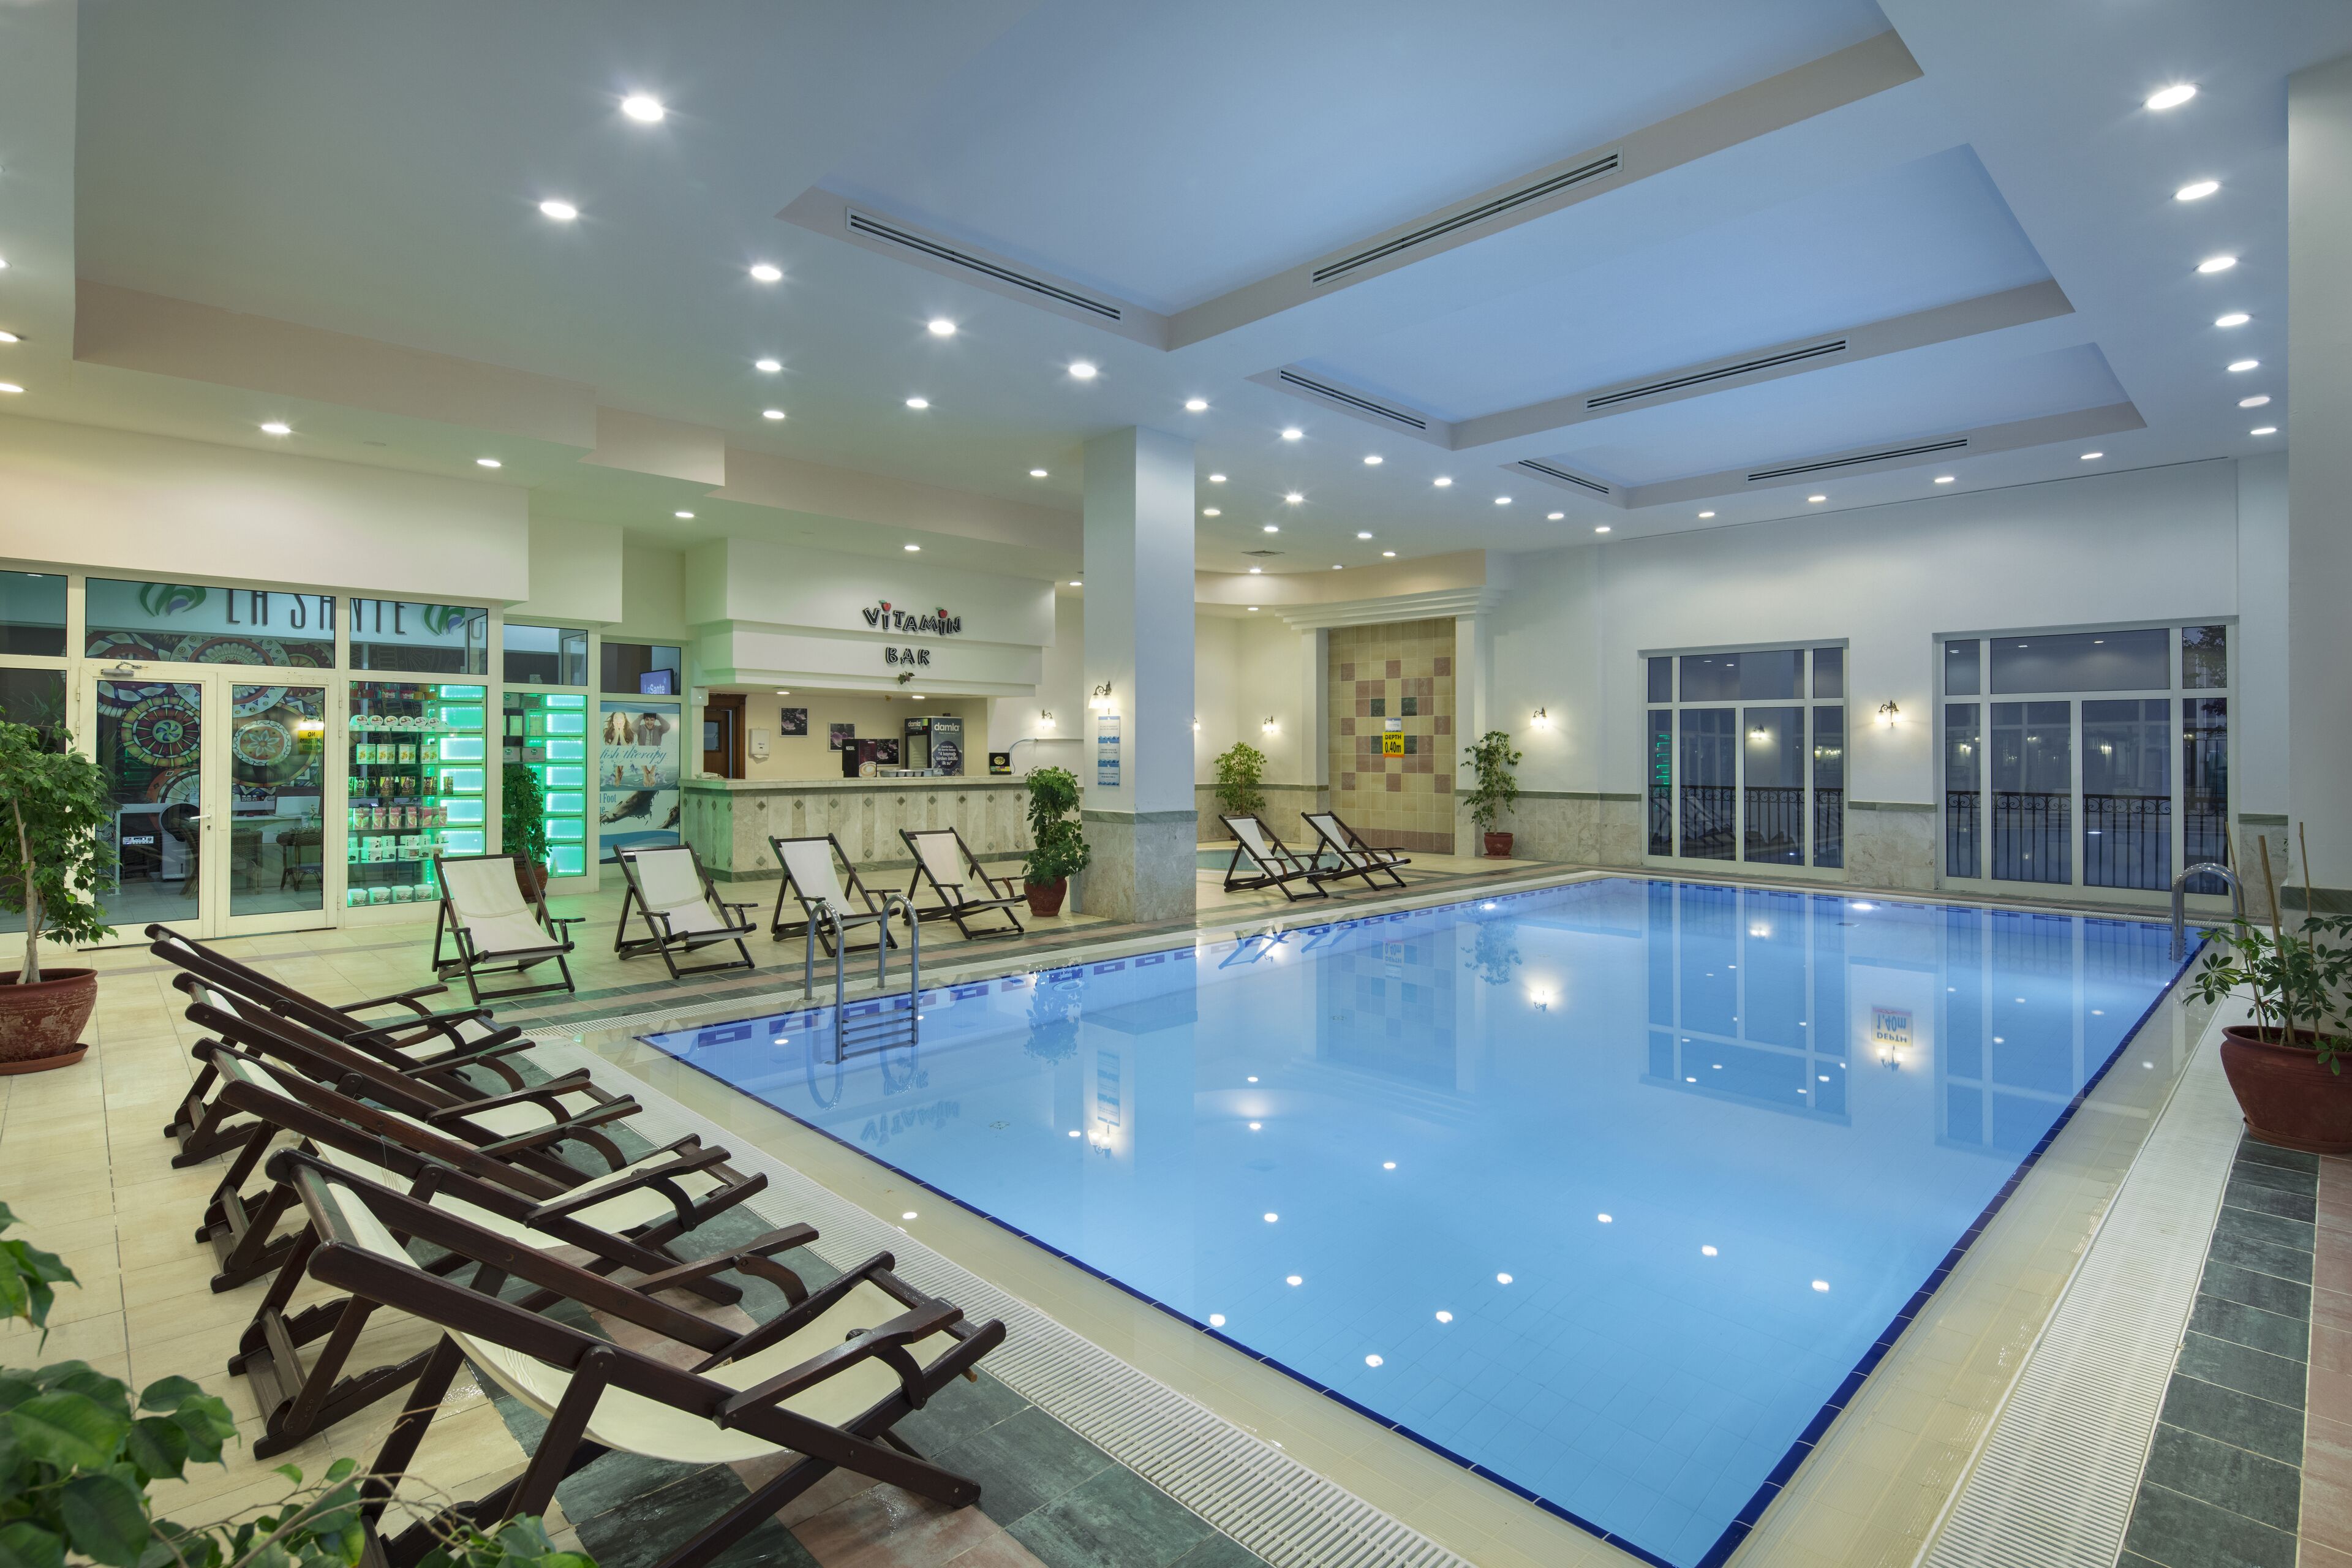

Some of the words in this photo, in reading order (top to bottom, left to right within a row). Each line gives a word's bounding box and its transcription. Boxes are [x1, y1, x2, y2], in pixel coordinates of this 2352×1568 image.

[227, 589, 268, 625] LA
[886, 647, 930, 665] BAR
[934, 722, 959, 731] damla
[1385, 741, 1401, 753] 0.40m
[600, 747, 619, 759] fish
[624, 746, 667, 764] therapy
[603, 793, 616, 803] Foot
